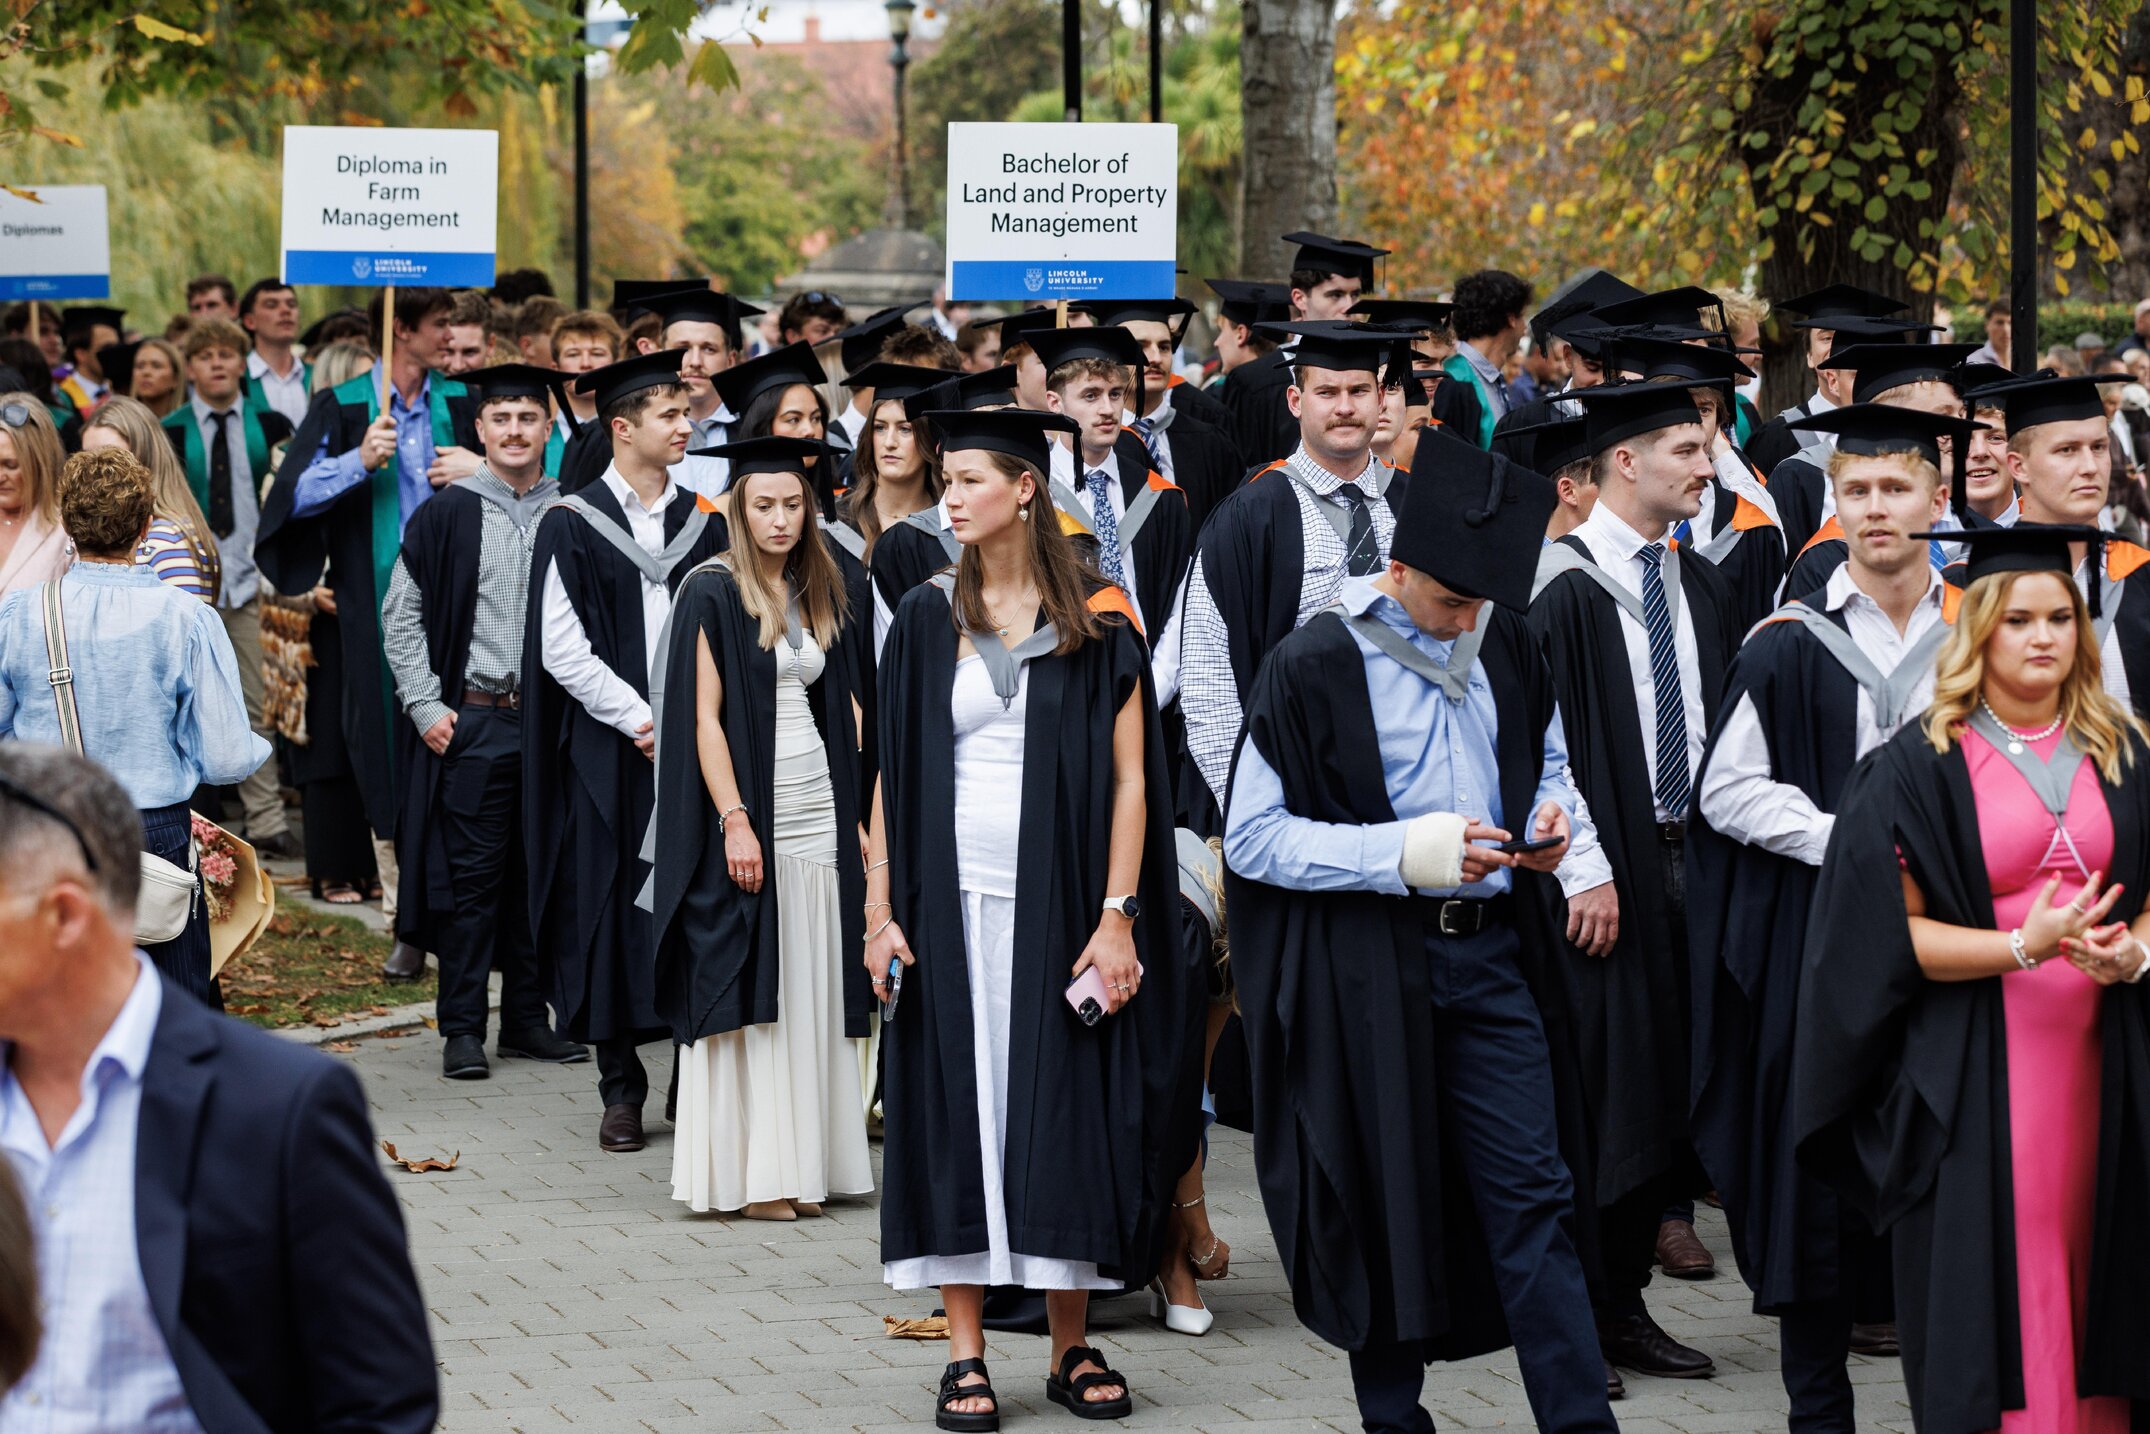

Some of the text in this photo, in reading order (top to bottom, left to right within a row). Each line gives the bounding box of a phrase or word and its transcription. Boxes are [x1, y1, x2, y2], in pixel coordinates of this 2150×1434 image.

[336, 154, 447, 177] Diploma in
[1002, 152, 1129, 174] Bachelor of
[368, 181, 420, 201] Farm
[963, 182, 1167, 208] Land and Property
[2, 223, 64, 237] Diplomas
[322, 207, 459, 231] Management
[991, 212, 1138, 237] Management
[374, 265, 428, 273] UNIVERSITY
